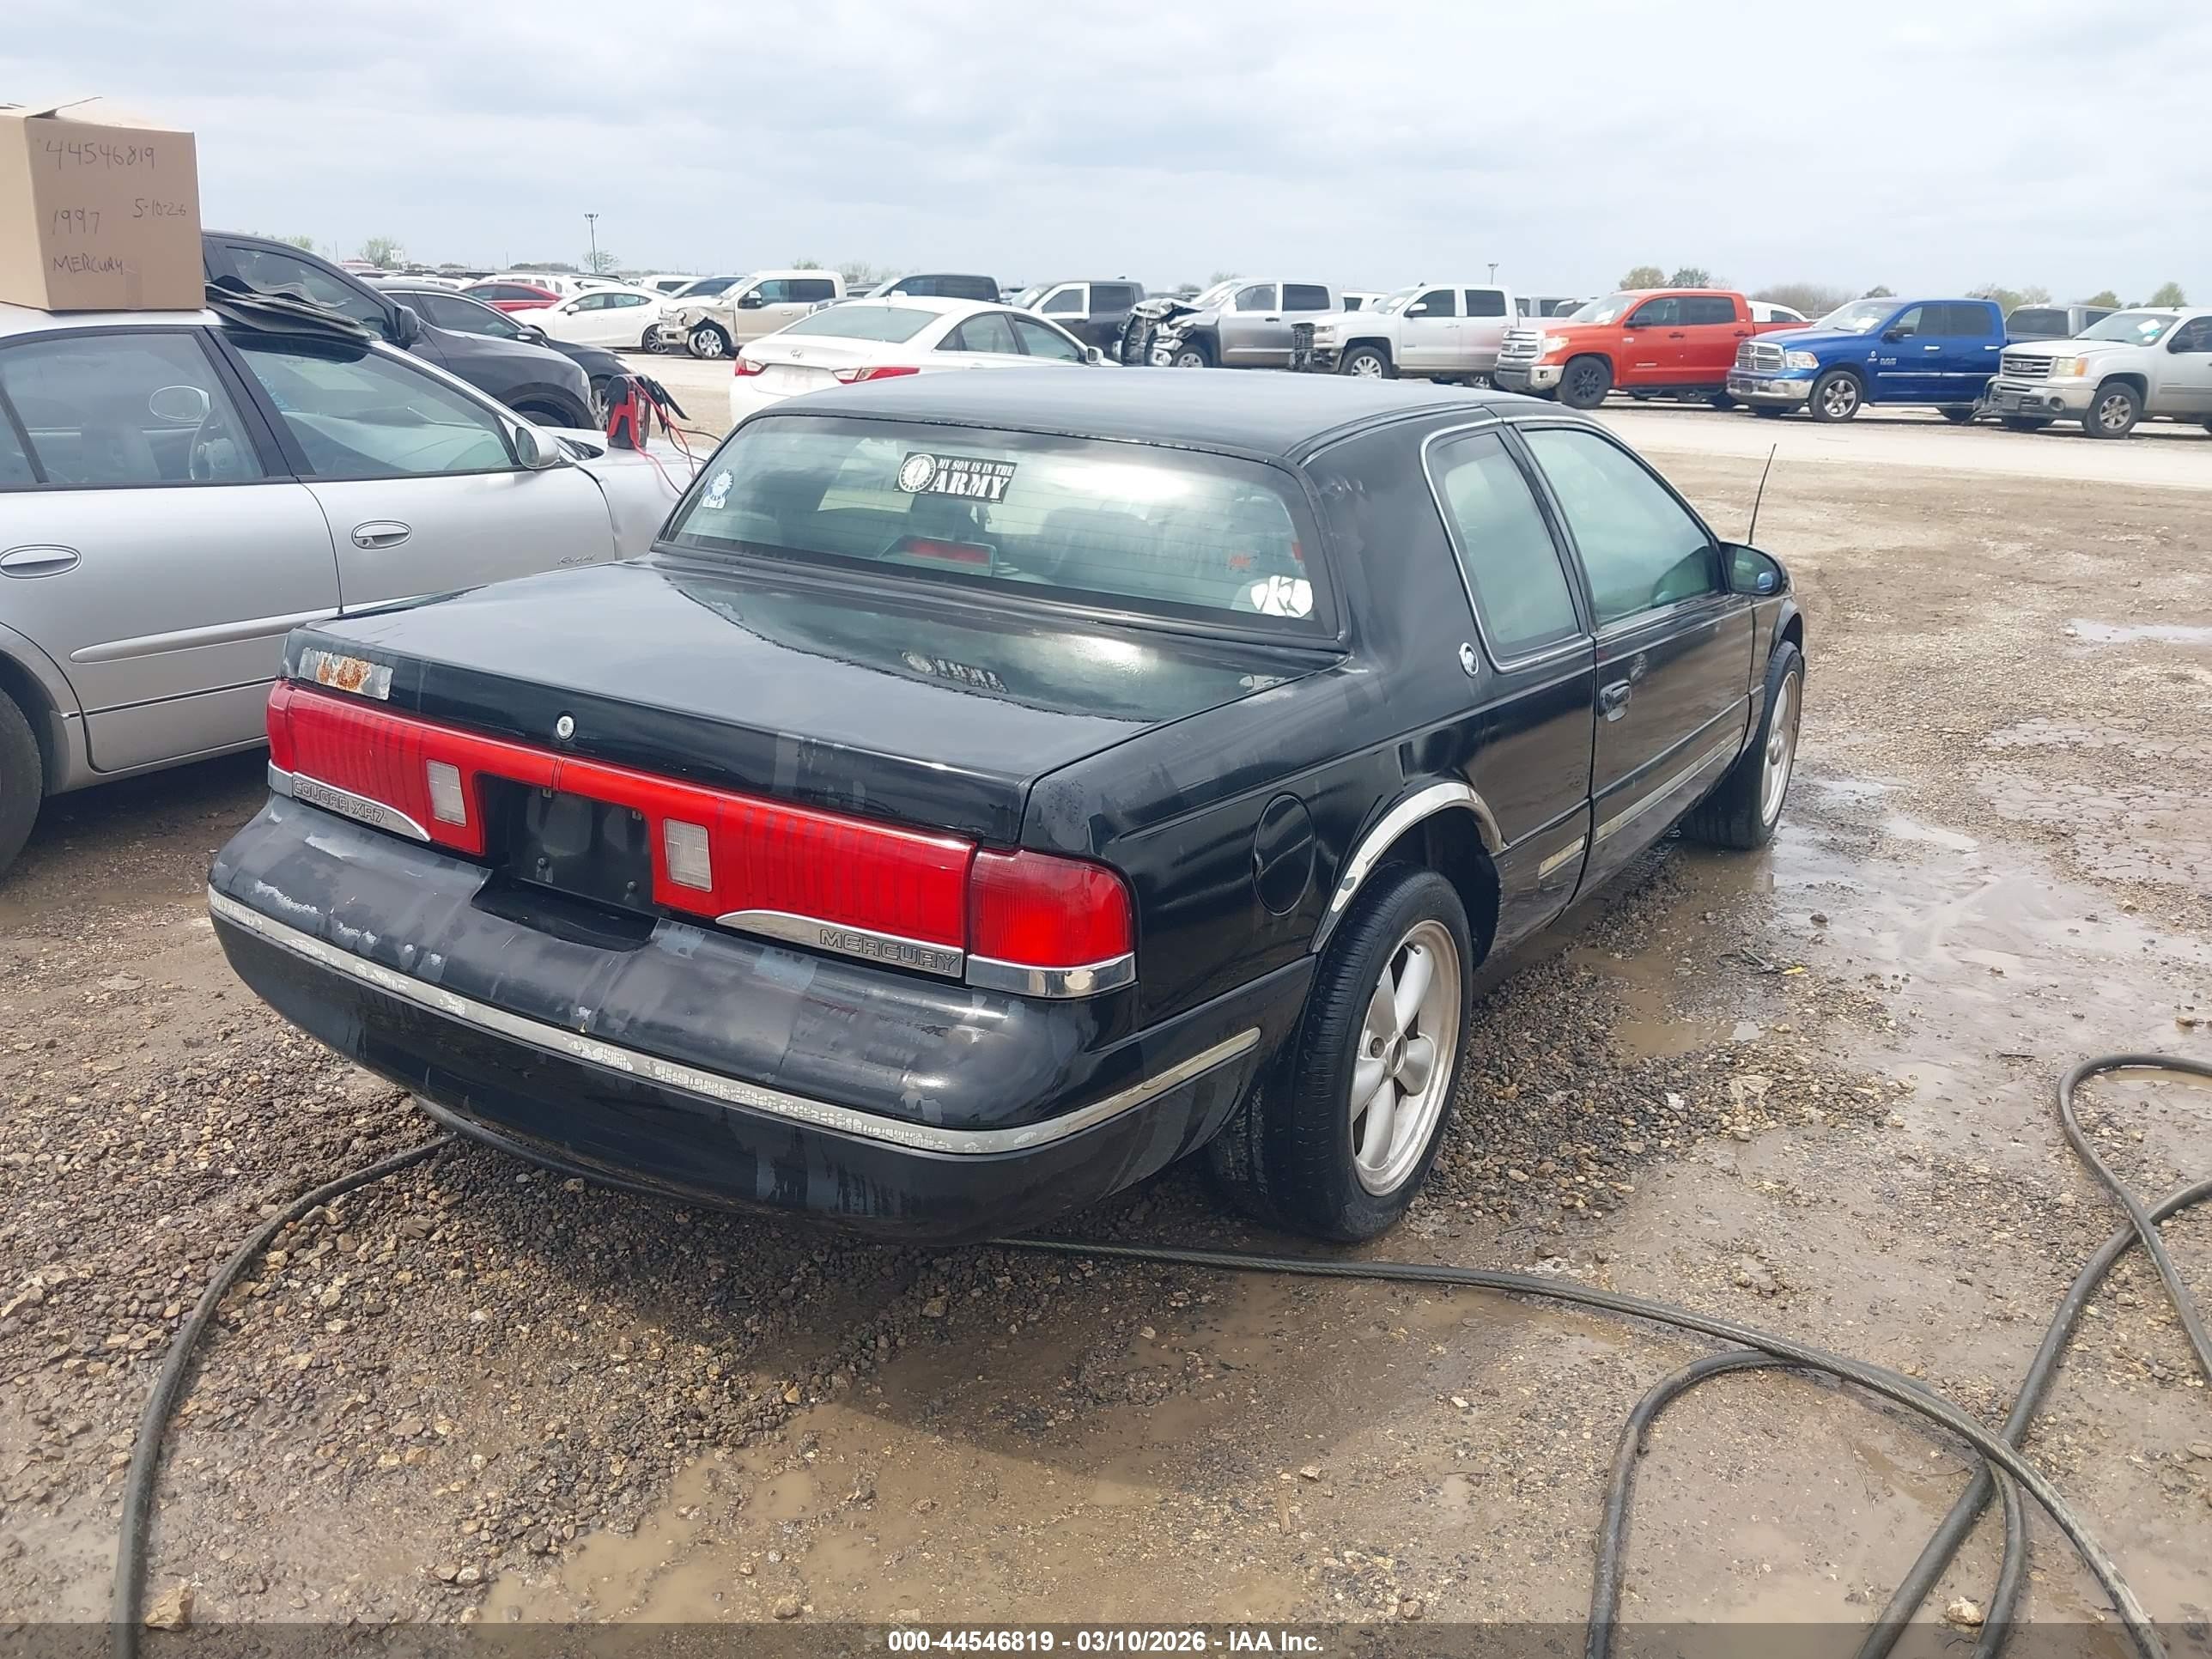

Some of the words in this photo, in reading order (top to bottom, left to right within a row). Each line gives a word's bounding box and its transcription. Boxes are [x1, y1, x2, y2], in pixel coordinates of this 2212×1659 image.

[46, 139, 155, 170] 44546819
[52, 207, 100, 236] 1997
[52, 252, 124, 275] MERCURY
[937, 458, 952, 470] MY
[951, 459, 970, 471] SON
[970, 461, 983, 473] IS
[982, 463, 995, 474] IN
[994, 465, 1015, 477] THE
[928, 471, 1011, 499] ARMY
[294, 779, 349, 812] COUGAR
[351, 800, 386, 823] XR7
[819, 928, 959, 972] MERCURY
